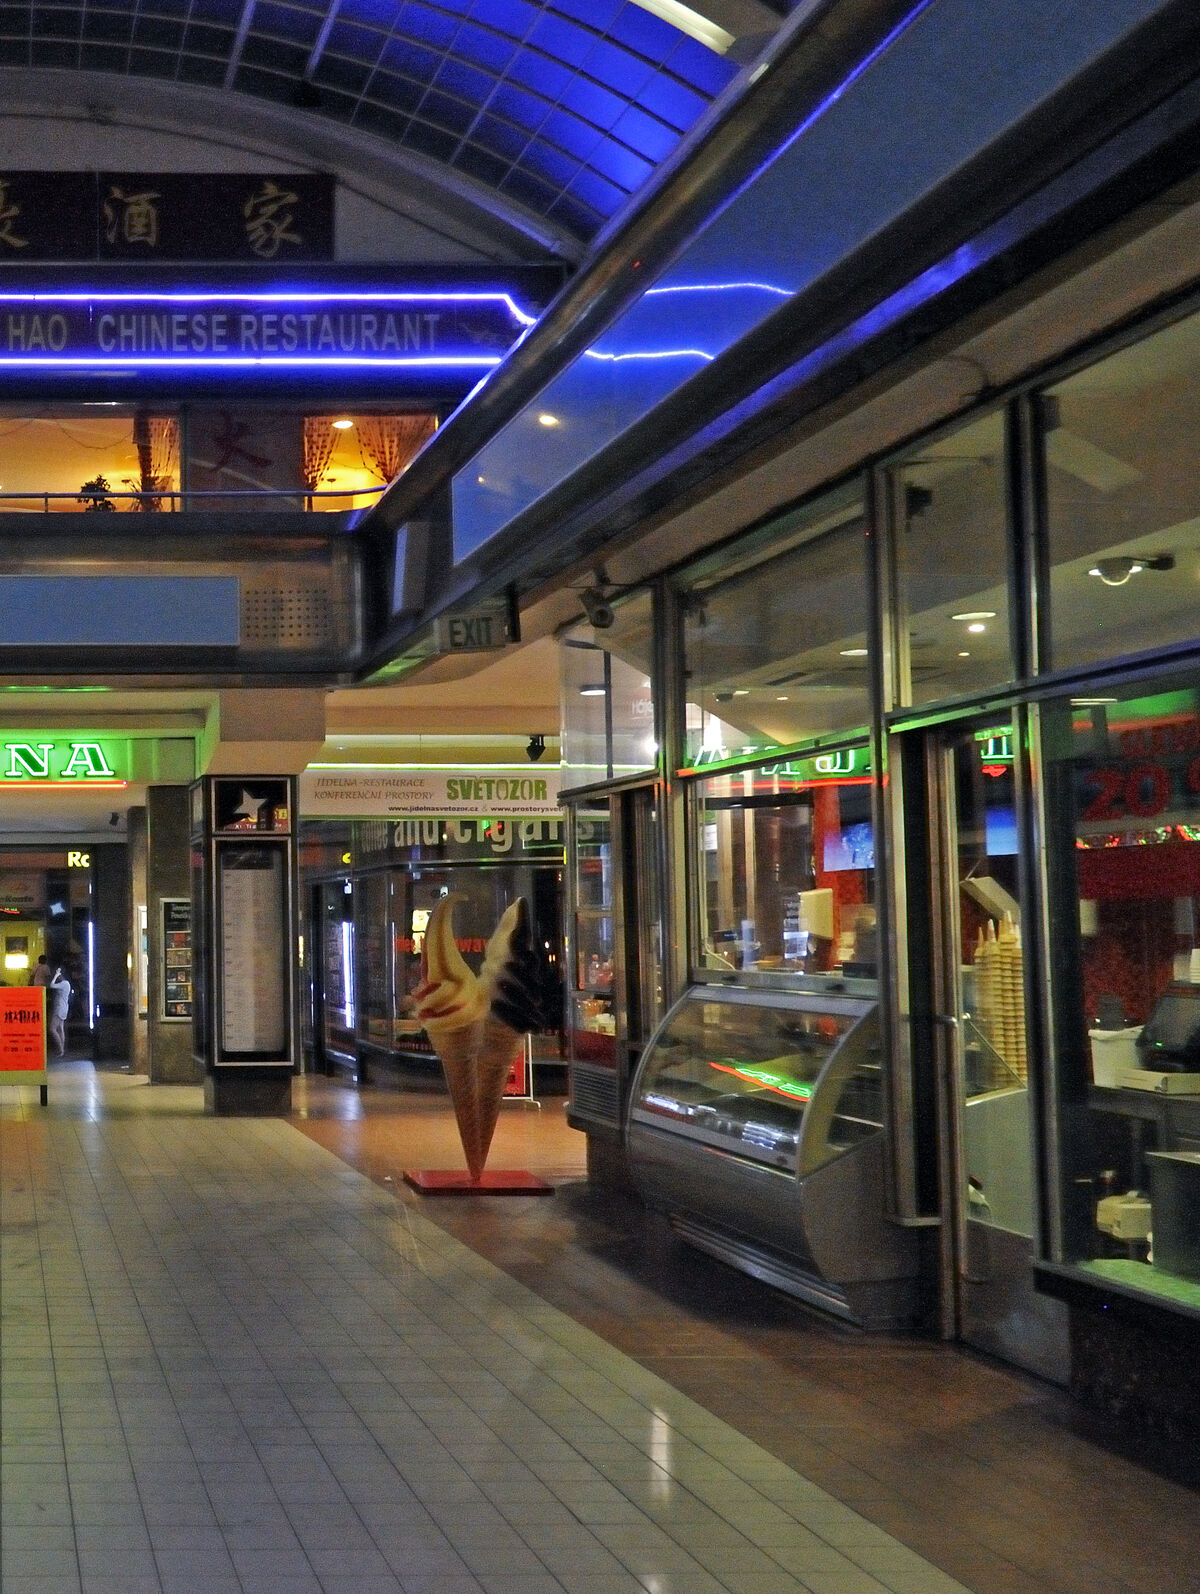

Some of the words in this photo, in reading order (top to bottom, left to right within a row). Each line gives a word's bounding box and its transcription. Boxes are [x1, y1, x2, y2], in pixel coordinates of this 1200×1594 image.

[7, 313, 68, 352] HAO
[99, 313, 229, 352] CHINESE
[241, 312, 441, 352] RESTAURANT
[449, 616, 493, 648] EXIT
[384, 790, 435, 801] PROSTORY
